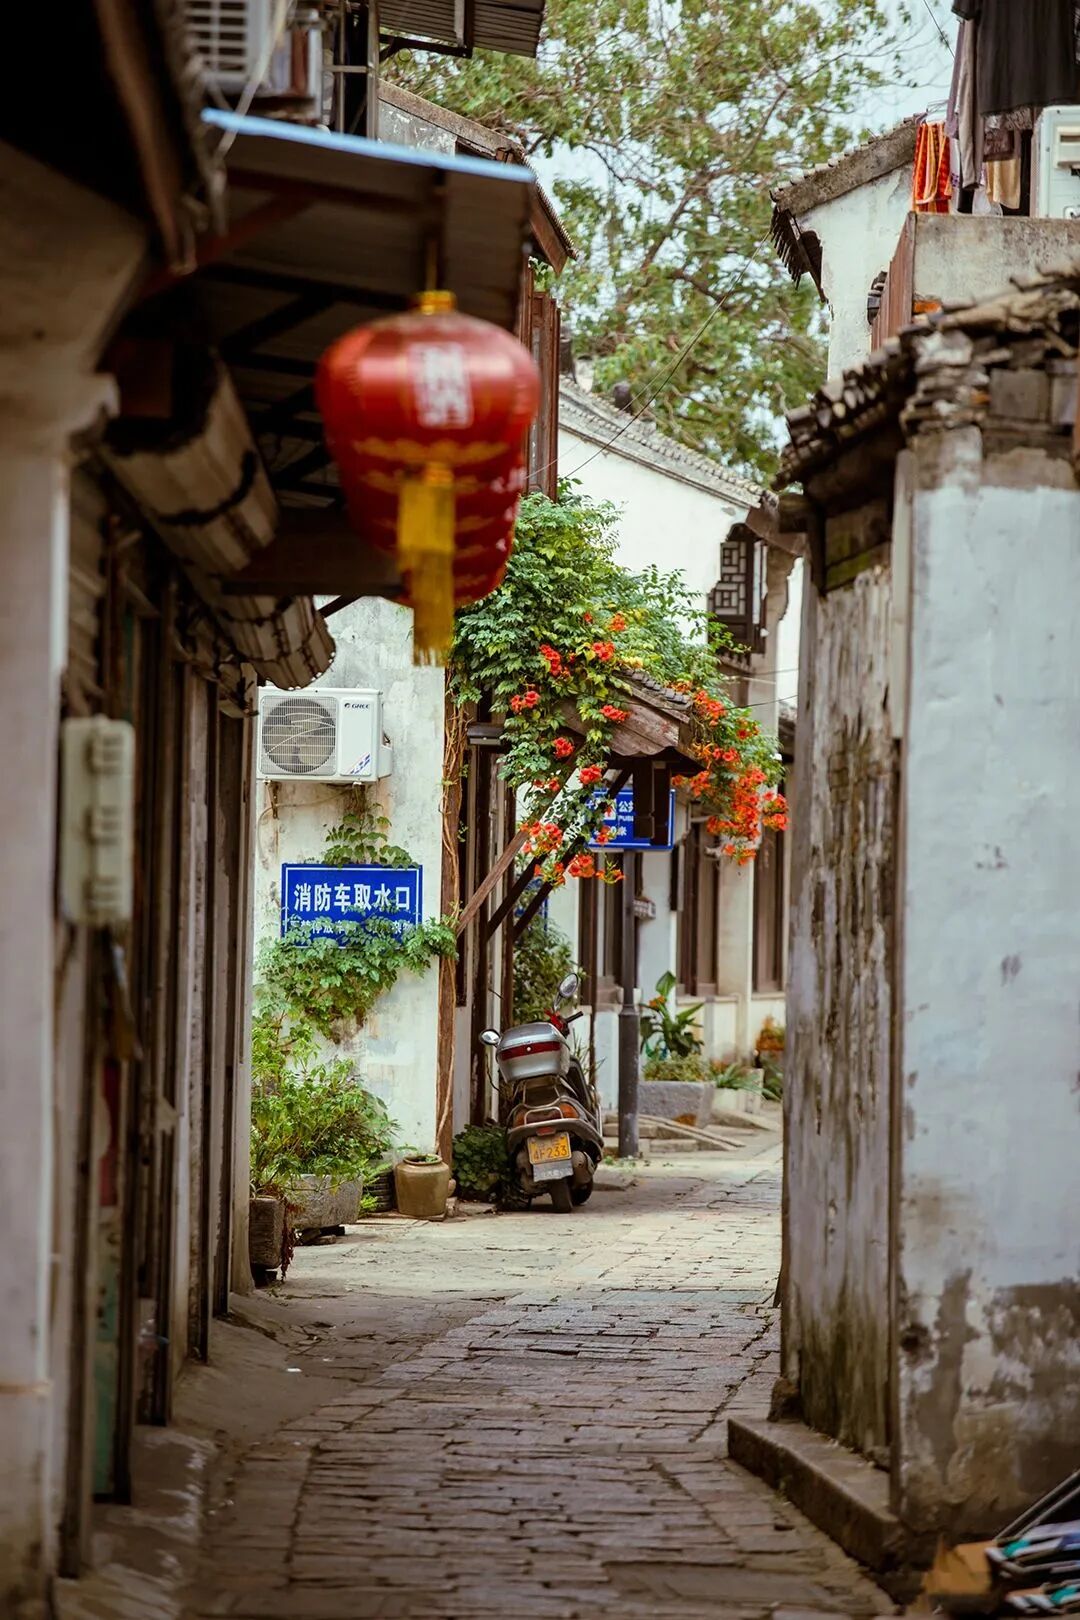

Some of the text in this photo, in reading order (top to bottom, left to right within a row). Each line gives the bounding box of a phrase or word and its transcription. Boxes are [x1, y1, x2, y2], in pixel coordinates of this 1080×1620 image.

[293, 882, 410, 912] 消防车取水口
